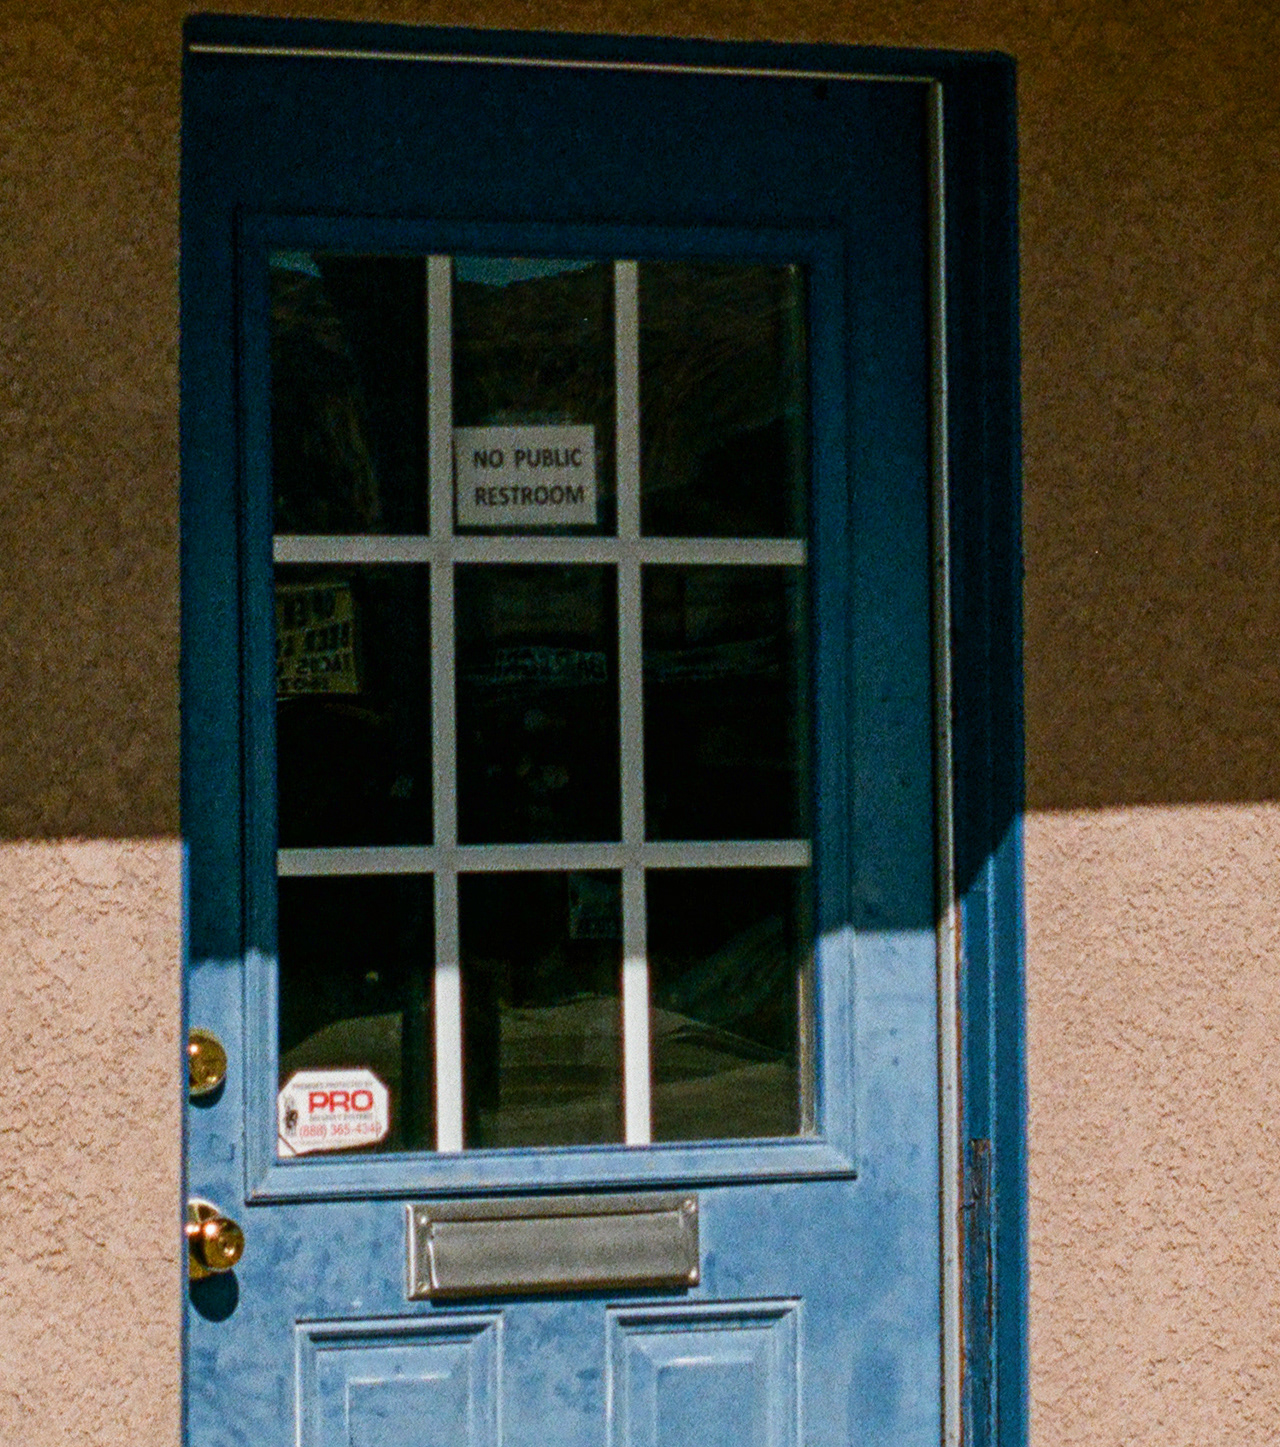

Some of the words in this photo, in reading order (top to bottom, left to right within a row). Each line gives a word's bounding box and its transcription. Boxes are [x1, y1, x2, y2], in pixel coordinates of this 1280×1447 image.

[473, 449, 505, 469] NO
[514, 447, 583, 468] PUBLIC
[475, 484, 585, 506] RESTROOM
[309, 1089, 375, 1113] PRO
